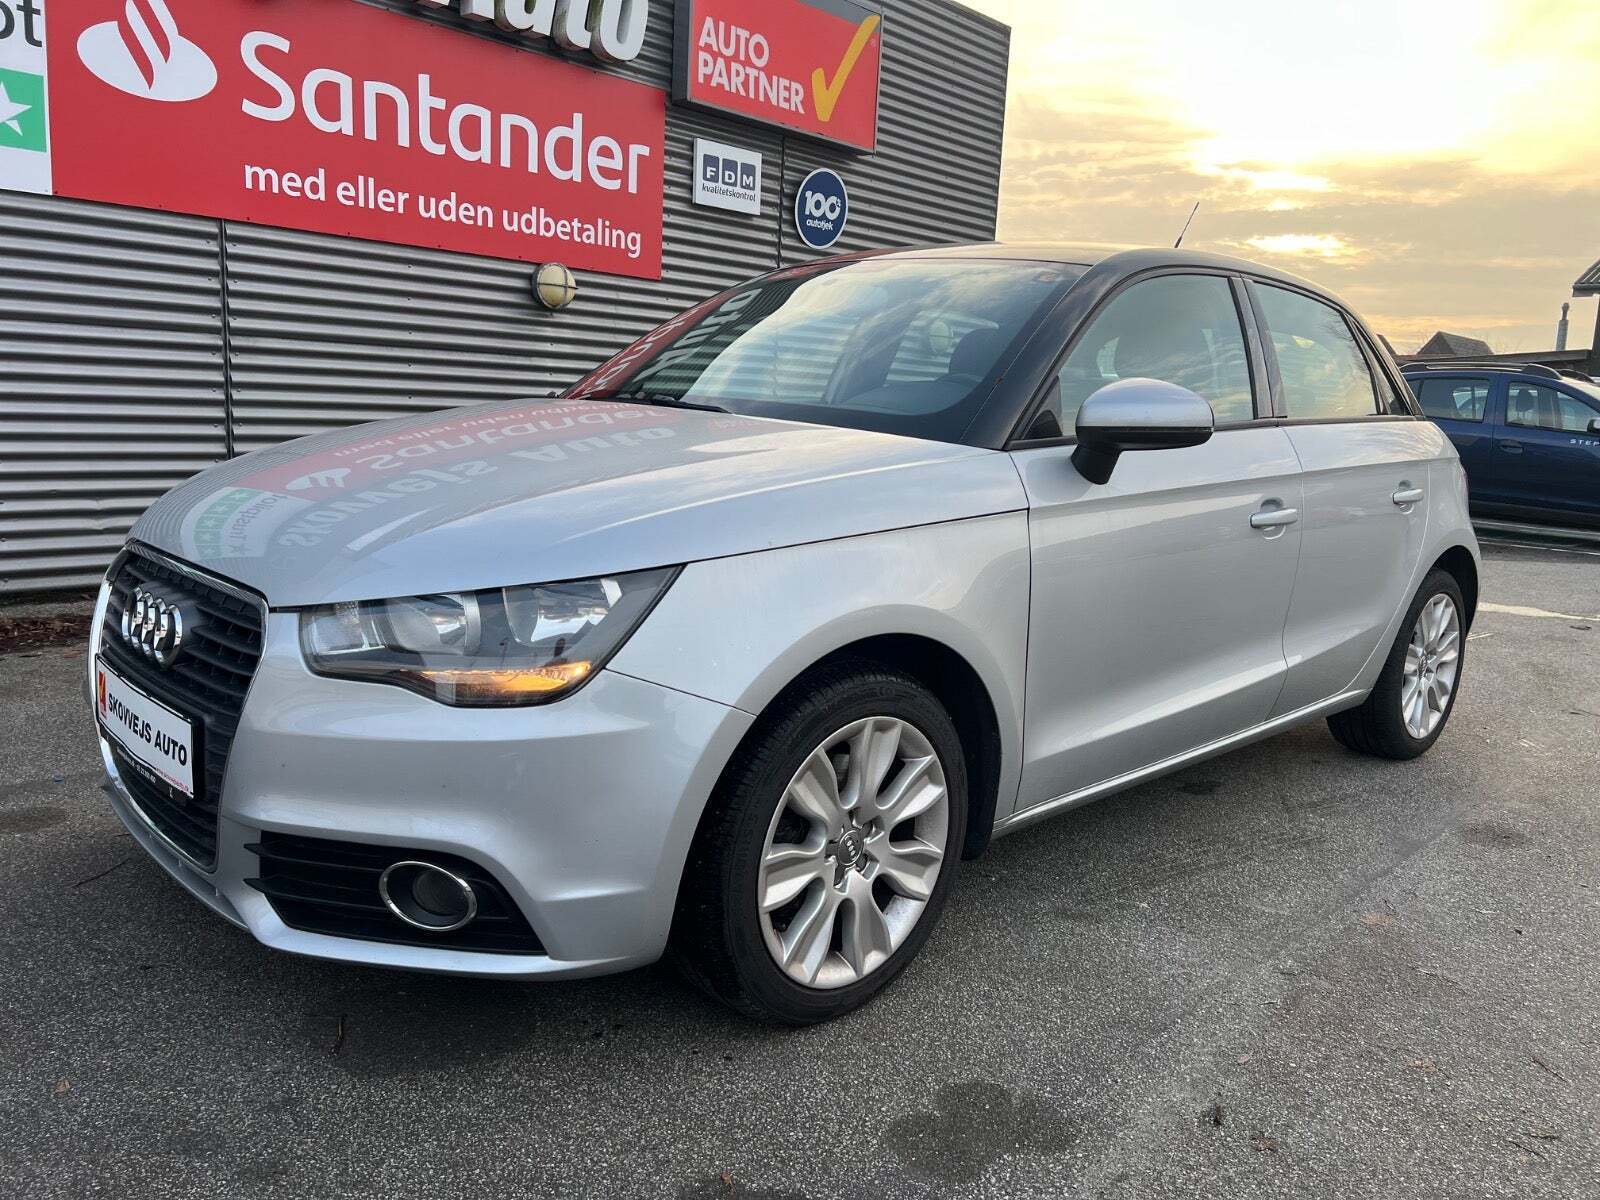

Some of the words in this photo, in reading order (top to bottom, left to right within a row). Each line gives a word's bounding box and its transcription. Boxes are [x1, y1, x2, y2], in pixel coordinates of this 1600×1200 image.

[699, 16, 769, 68] AUTO
[240, 30, 650, 194] Santander
[698, 51, 805, 114] PARTNER
[702, 183, 756, 202] kvalitetskontrol
[706, 166, 754, 188] FDM
[244, 164, 326, 201] med
[336, 175, 409, 214] eller
[418, 192, 494, 228] uden
[503, 206, 641, 259] udbetaling
[108, 692, 152, 744] SKOVVEJS
[154, 729, 188, 767] AUTO
